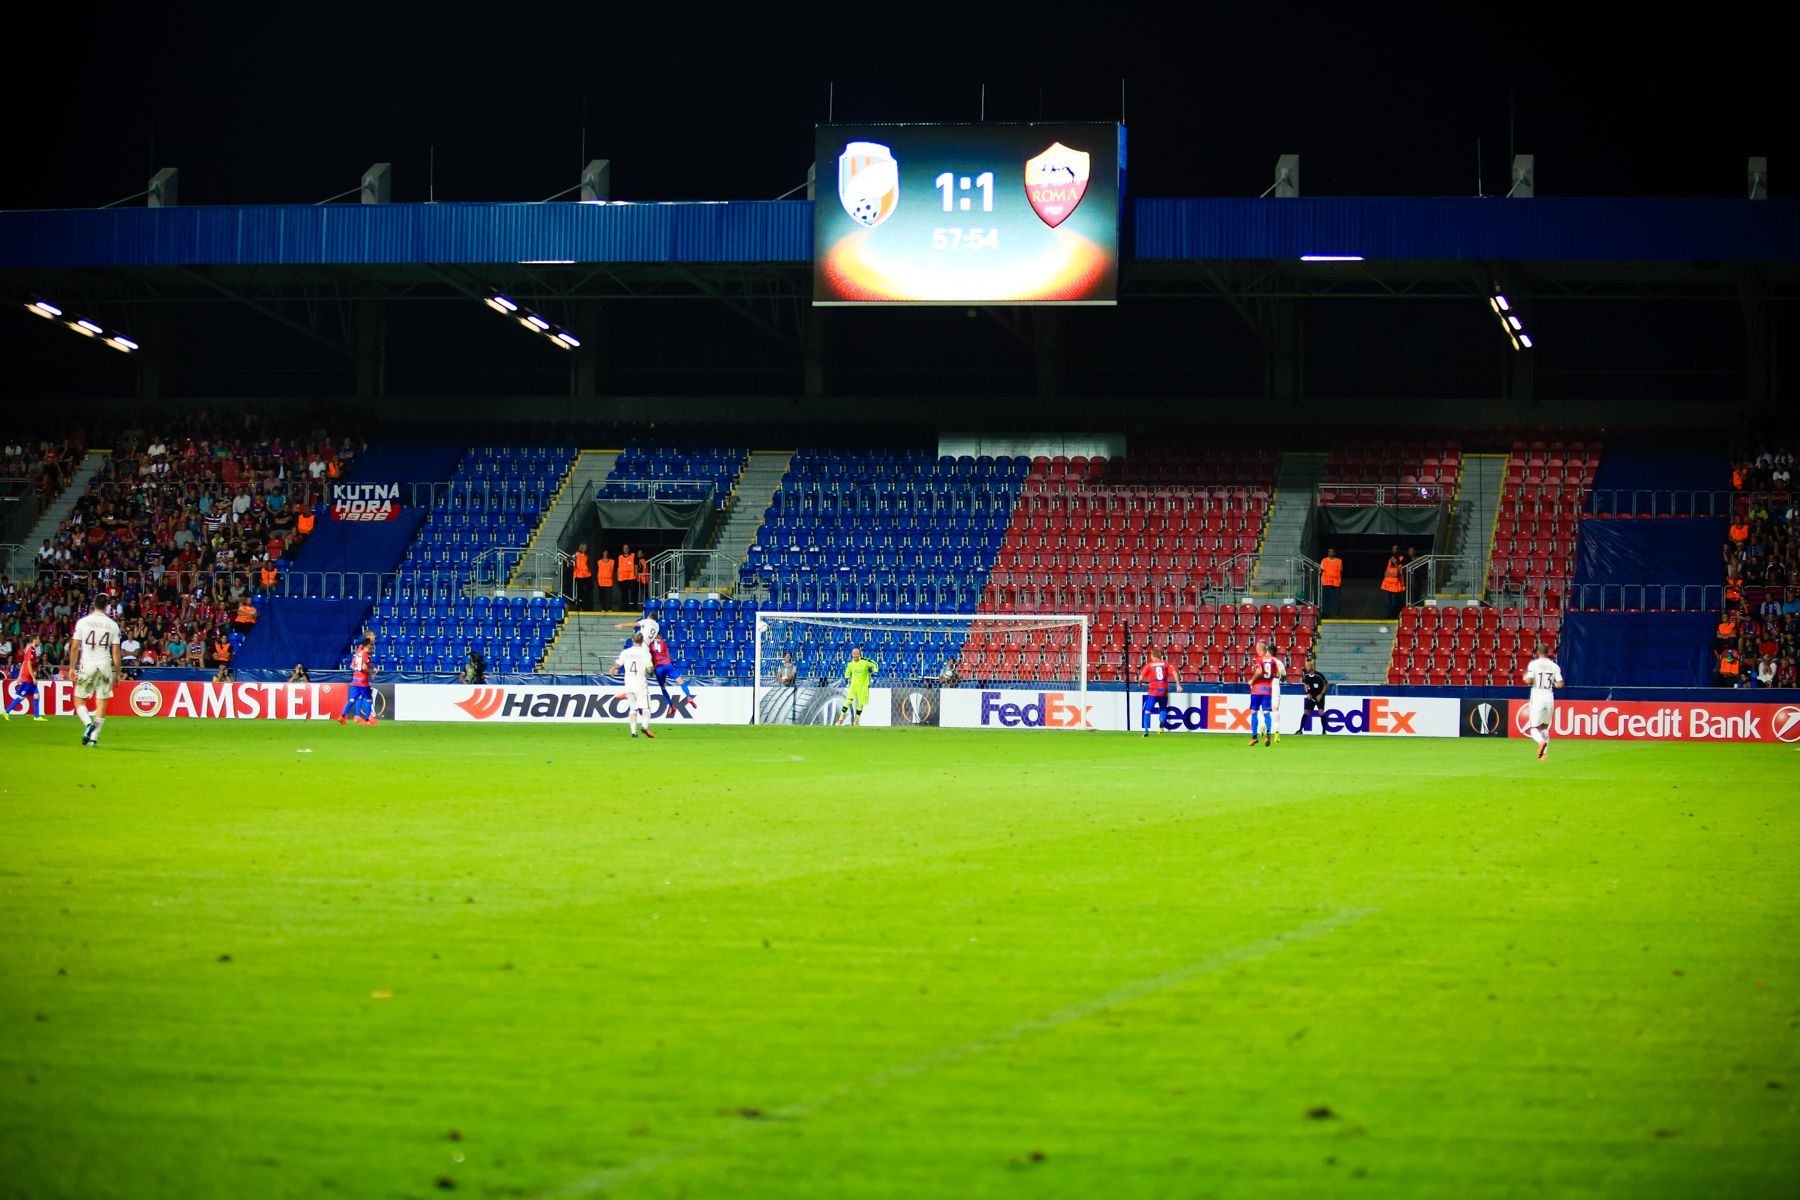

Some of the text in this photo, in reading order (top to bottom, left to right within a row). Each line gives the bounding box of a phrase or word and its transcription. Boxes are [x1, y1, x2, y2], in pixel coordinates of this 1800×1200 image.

[936, 172, 994, 212] 1:1
[1033, 188, 1078, 203] ROMA
[932, 228, 998, 250] 57:54
[335, 499, 392, 513] HORA
[339, 512, 389, 521] 1996
[85, 630, 111, 651] 44
[648, 628, 657, 640] 9
[629, 661, 638, 676] 4
[1155, 666, 1164, 681] 8
[1263, 662, 1272, 679] 9
[1537, 672, 1554, 690] 13
[981, 691, 1093, 727] FedEx
[1554, 706, 1761, 739] UniCredit Bank
